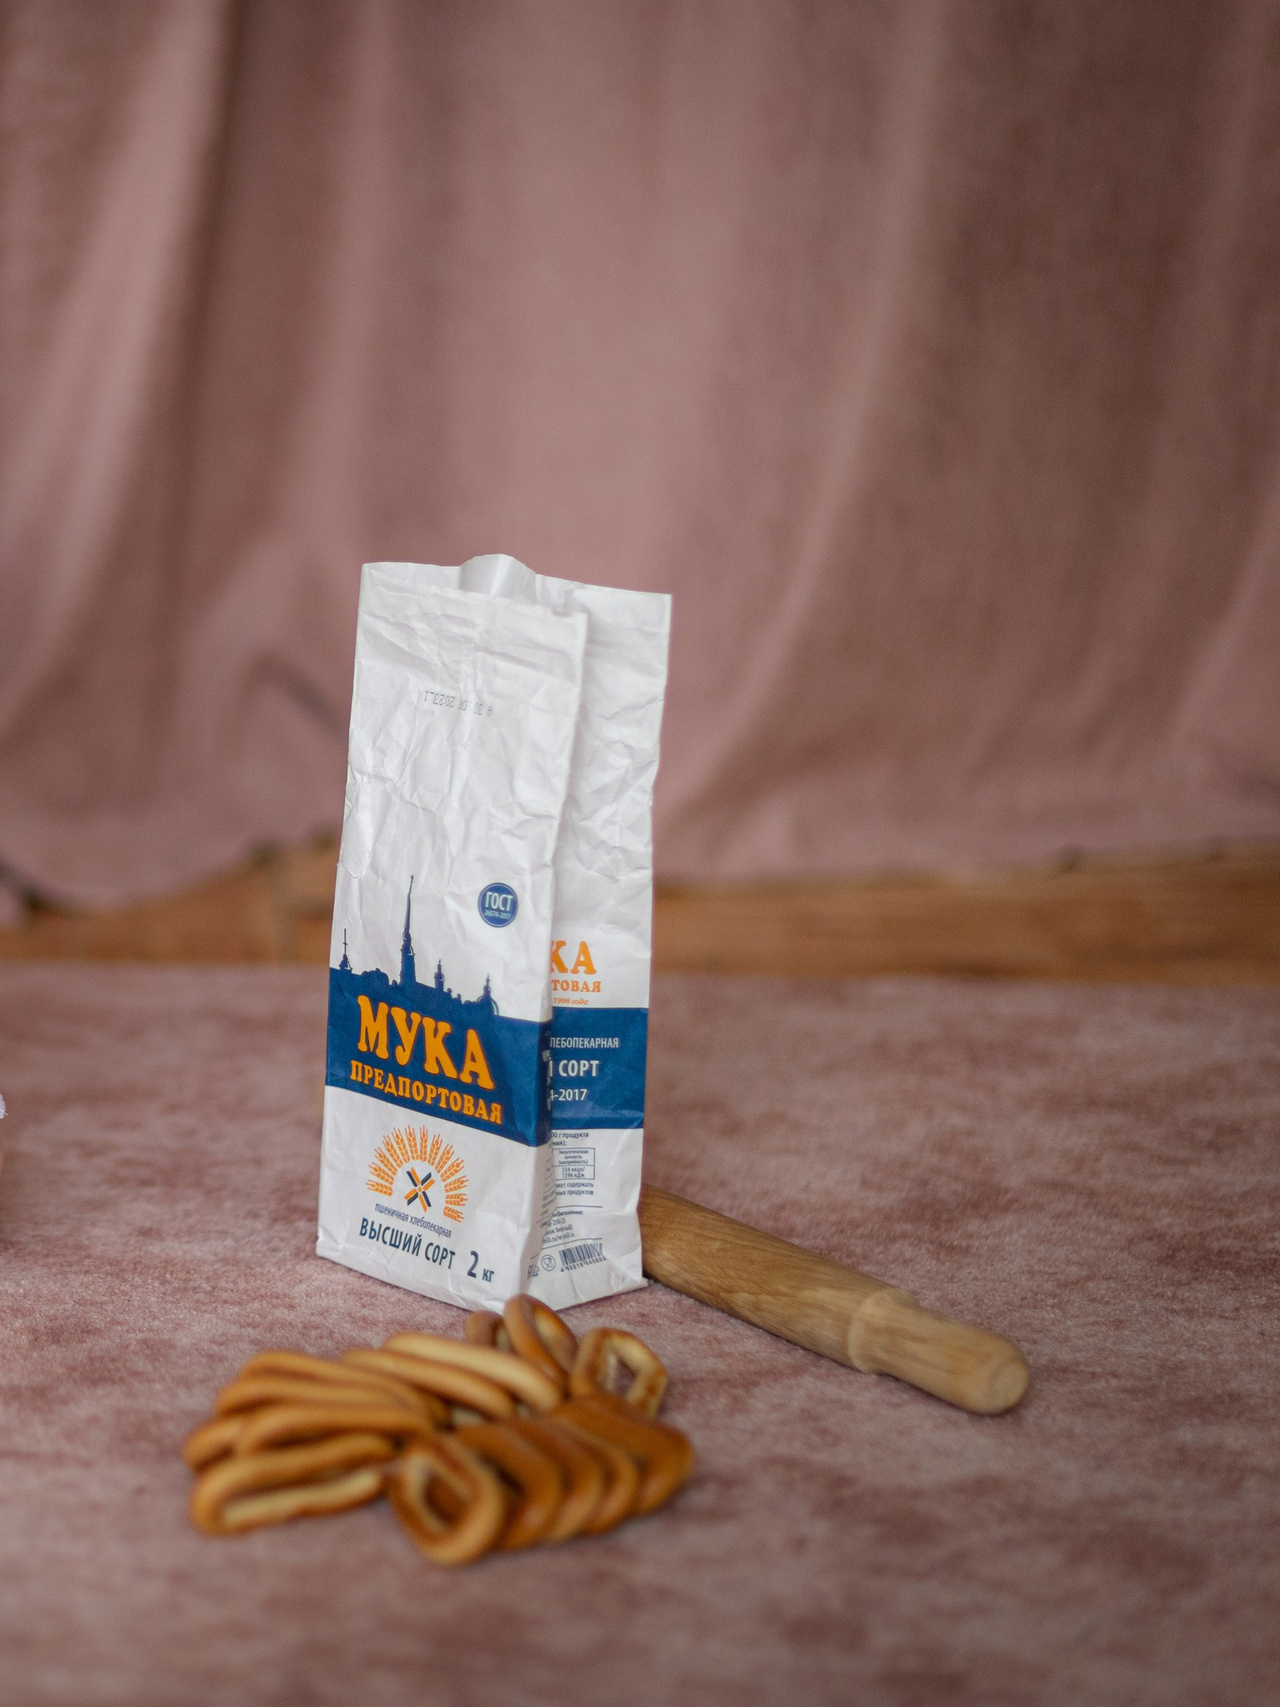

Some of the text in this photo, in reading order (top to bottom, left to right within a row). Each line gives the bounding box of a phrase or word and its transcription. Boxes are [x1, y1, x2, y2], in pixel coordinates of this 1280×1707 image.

[485, 891, 514, 912] ГОСТ
[550, 940, 597, 975] КА
[551, 979, 602, 993] ТОВАЯ
[553, 997, 589, 1006] 1996 года
[357, 995, 495, 1090] МУКА
[550, 1037, 619, 1049] ЛЕБОПЕКАРНАЯ
[558, 1059, 600, 1077] СОРТ
[350, 1060, 503, 1125] ПРЕДПОРТОВАЯ
[374, 1202, 453, 1239] пшеничная хлебопекарная
[359, 1217, 422, 1257] ВЫСШИЙ
[424, 1242, 456, 1270] СОРТ
[467, 1250, 480, 1278] 2
[482, 1266, 496, 1283] кг
